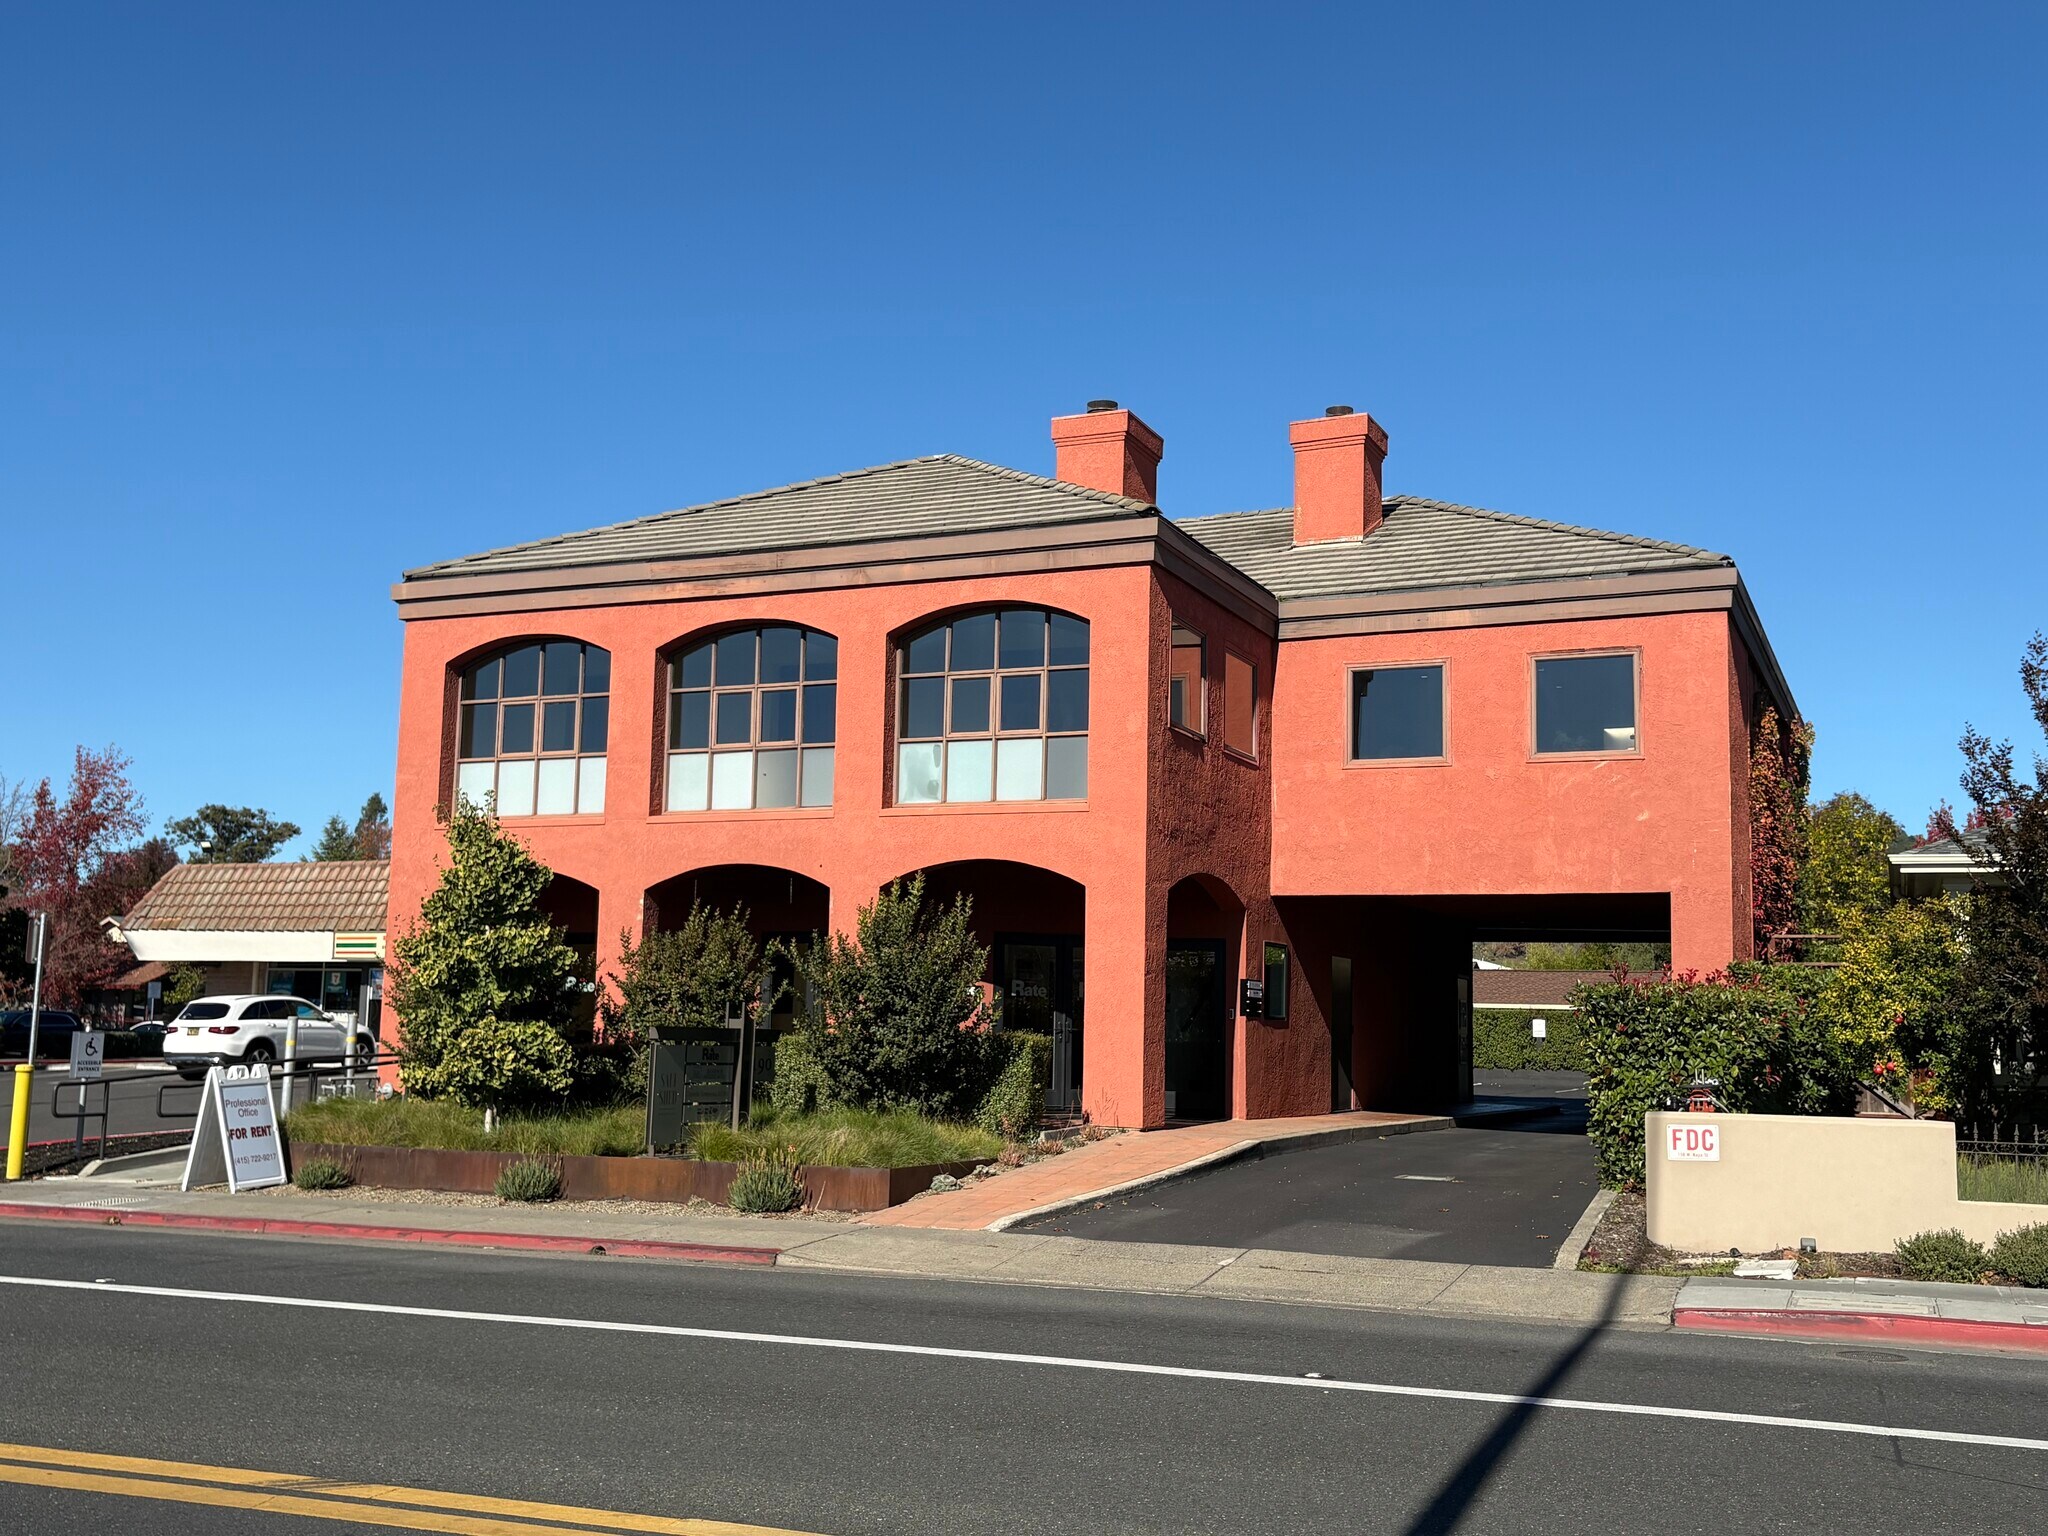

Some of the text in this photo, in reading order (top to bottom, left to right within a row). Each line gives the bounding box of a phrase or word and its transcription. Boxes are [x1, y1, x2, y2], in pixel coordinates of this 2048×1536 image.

[1011, 979, 1048, 997] Rate
[702, 1047, 720, 1060] Rate
[225, 1097, 267, 1108] Professional
[238, 1108, 258, 1118] Office
[230, 1125, 272, 1140] FOR RENT
[1672, 1129, 1714, 1151] FDC
[235, 1155, 250, 1166] (415)
